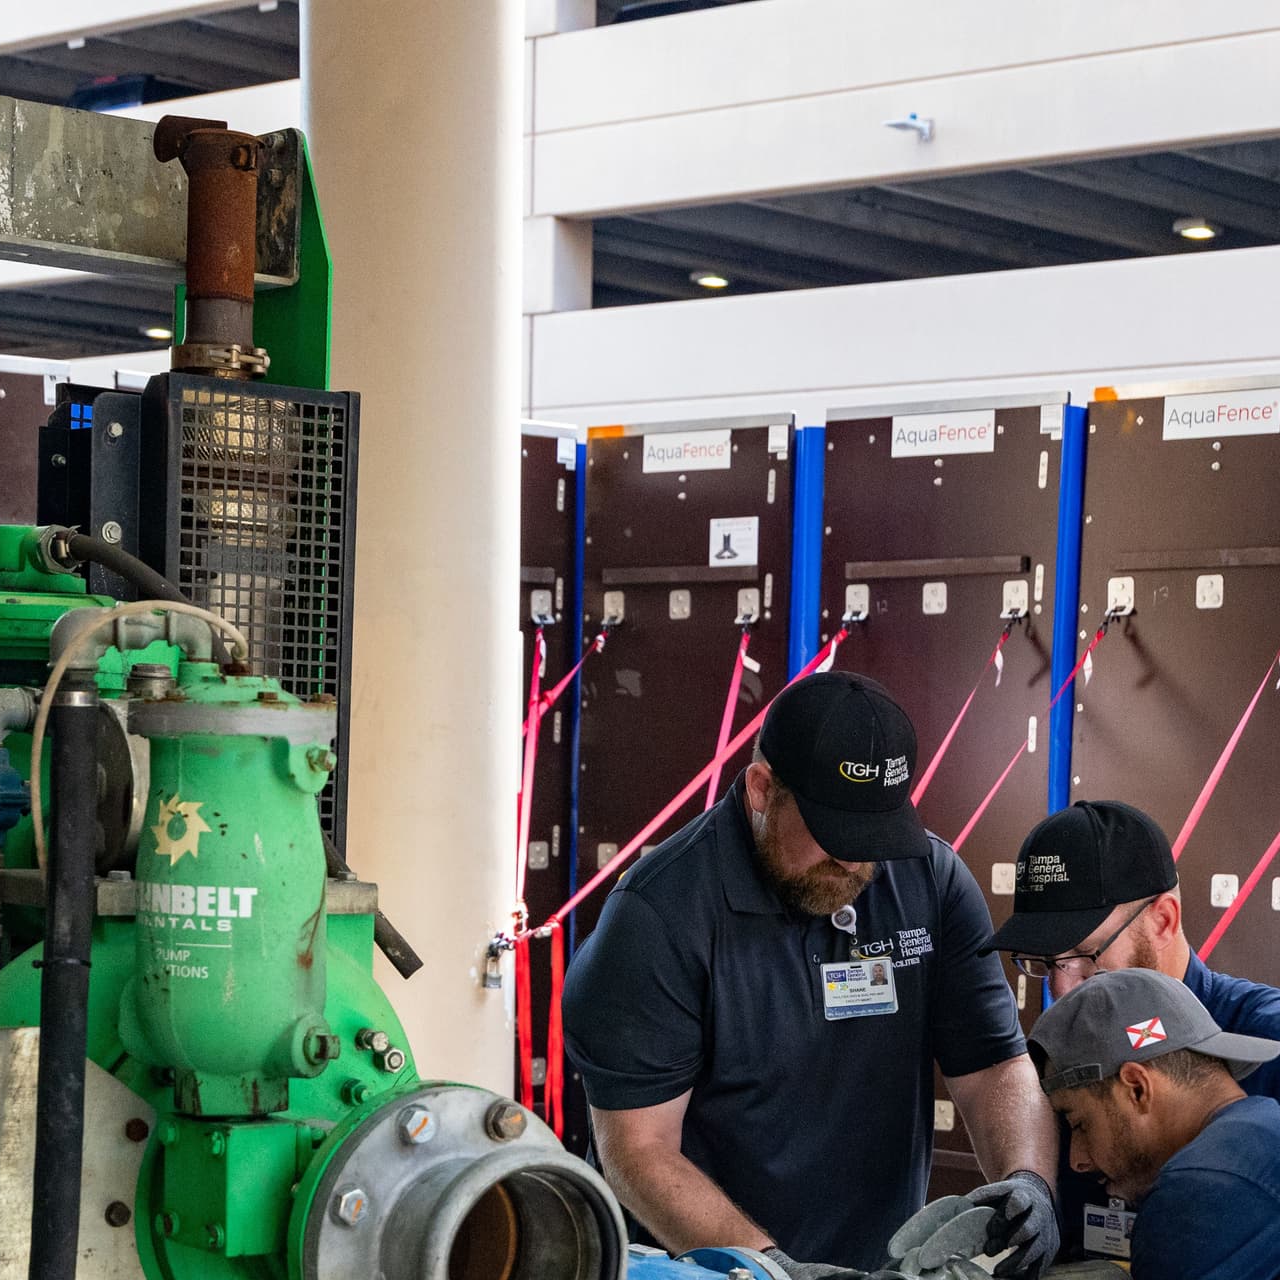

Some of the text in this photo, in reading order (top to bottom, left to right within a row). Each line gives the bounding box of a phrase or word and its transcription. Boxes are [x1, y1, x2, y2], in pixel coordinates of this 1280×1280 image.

[845, 761, 880, 777] TGH
[885, 762, 909, 777] General
[1029, 855, 1060, 866] Tampa
[1029, 863, 1065, 874] General
[896, 927, 927, 939] Tampa
[860, 938, 894, 955] TGH
[899, 934, 931, 948] General
